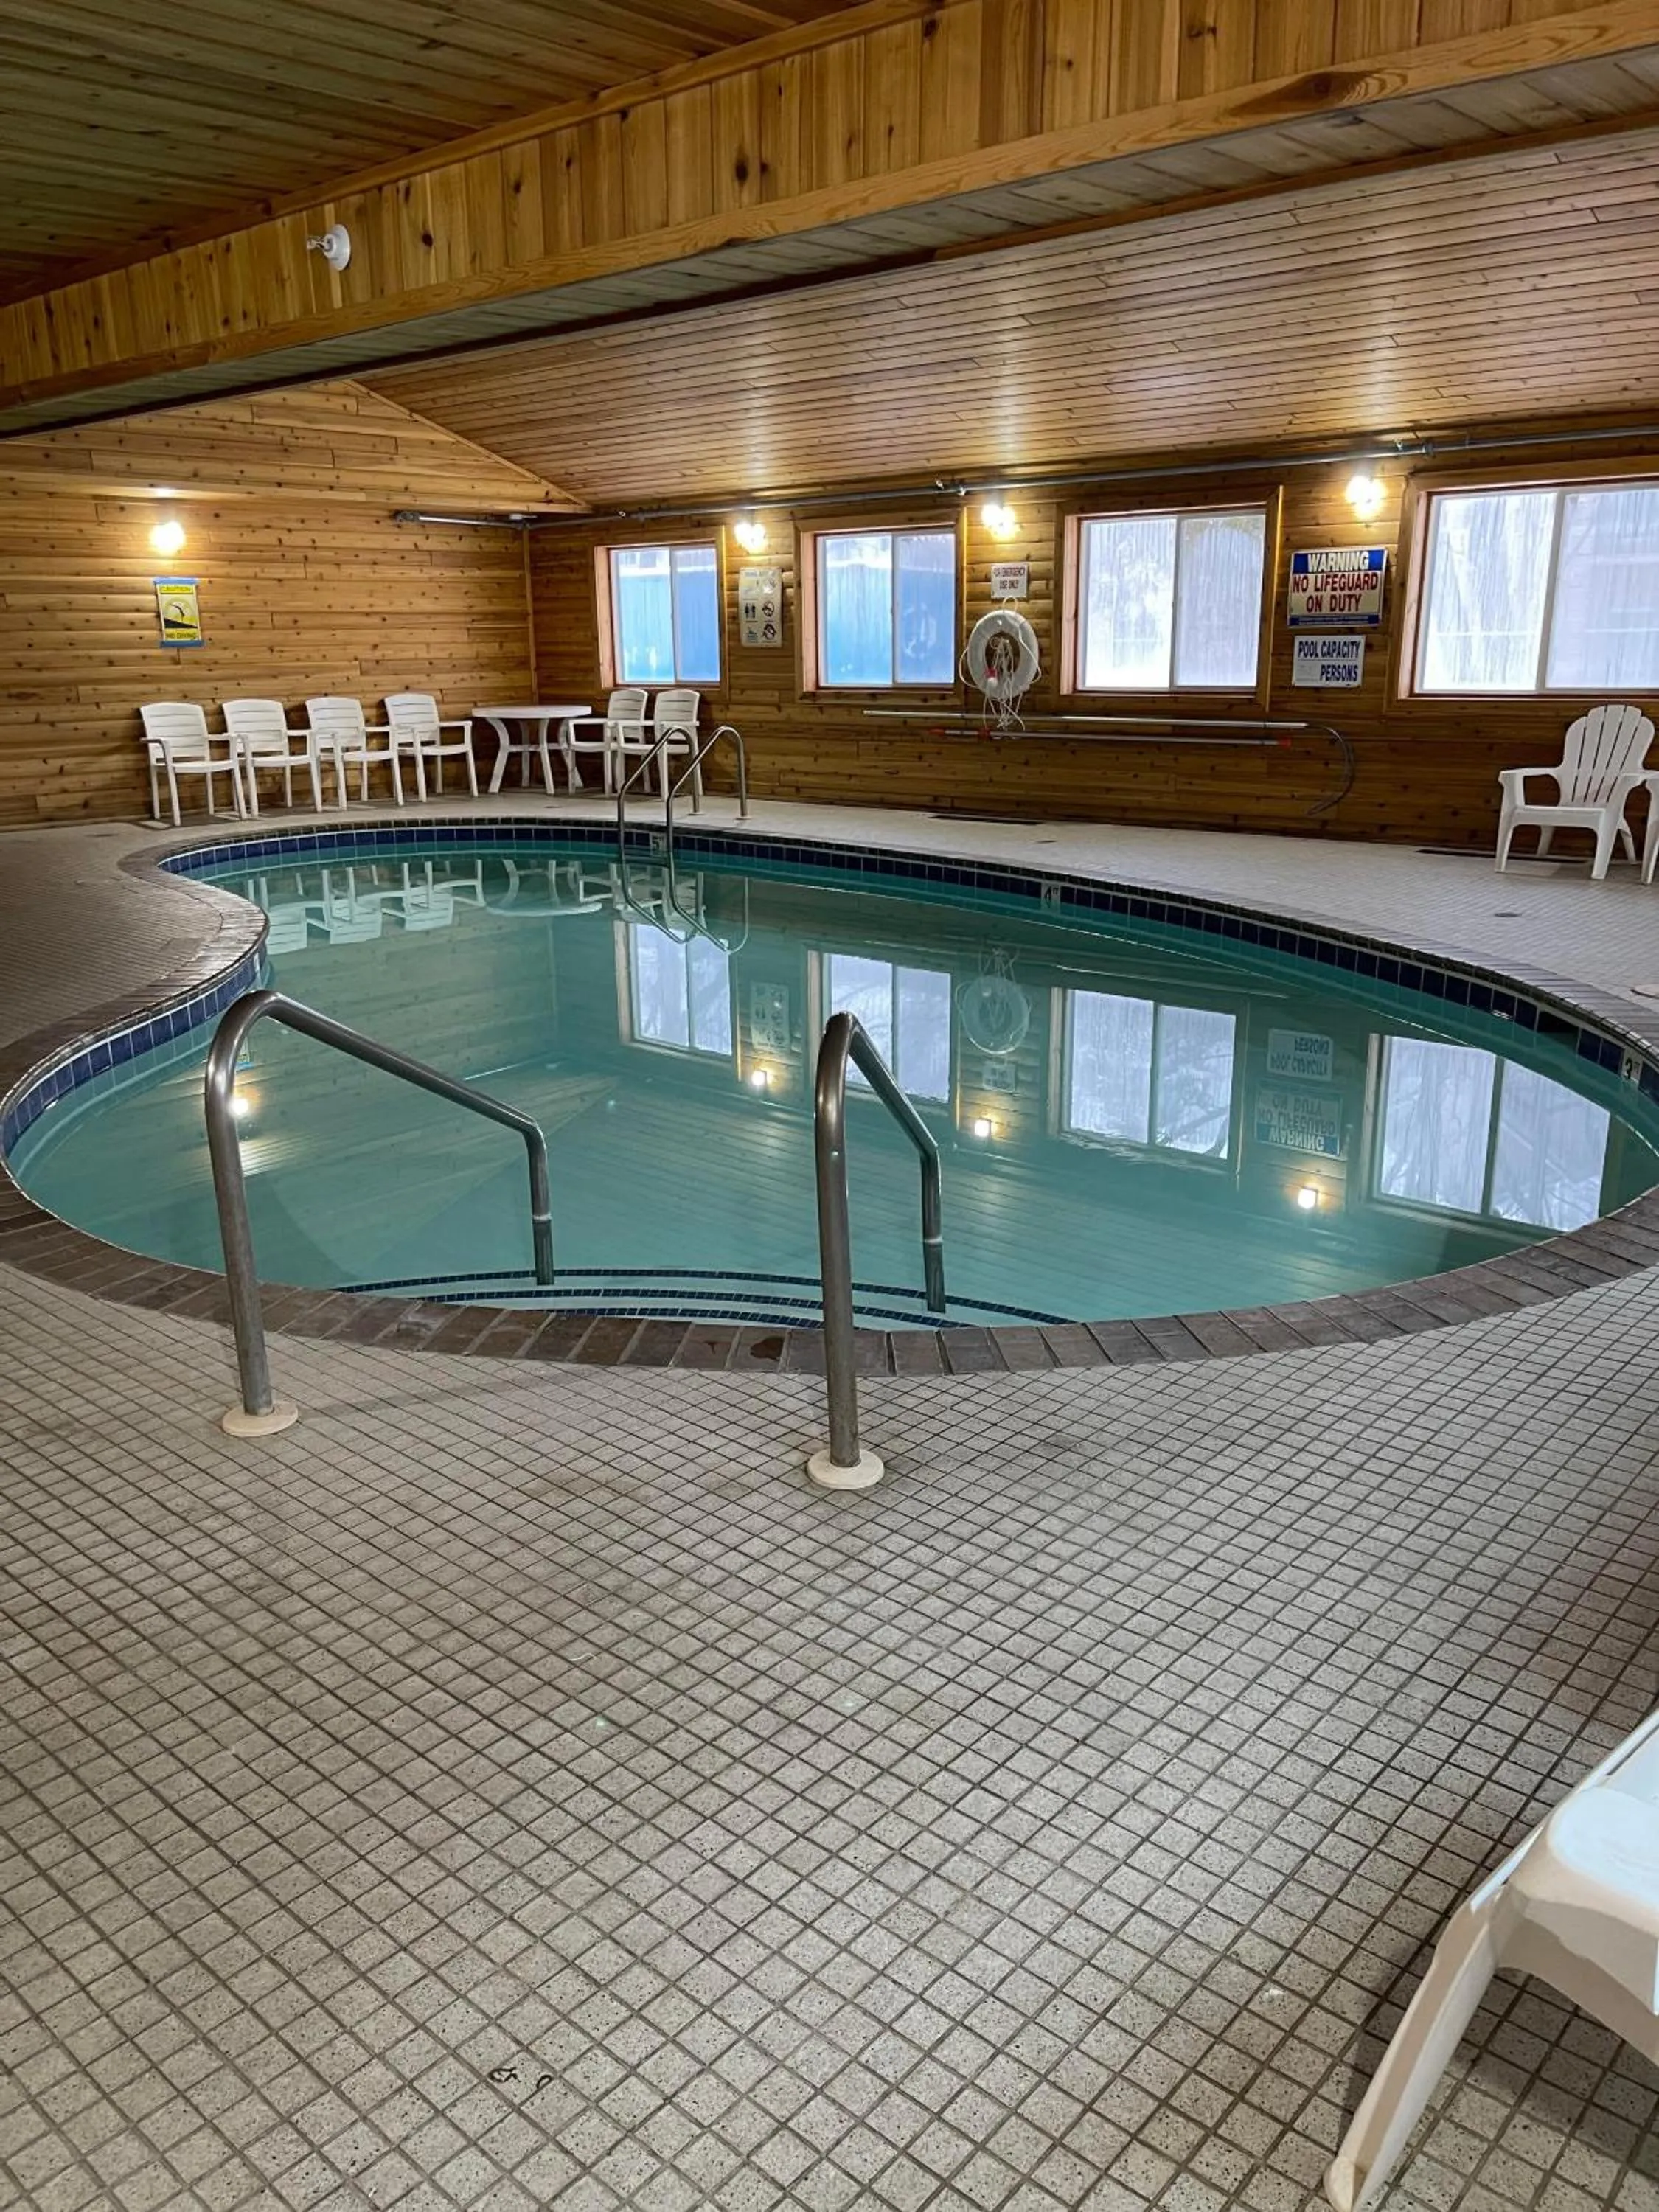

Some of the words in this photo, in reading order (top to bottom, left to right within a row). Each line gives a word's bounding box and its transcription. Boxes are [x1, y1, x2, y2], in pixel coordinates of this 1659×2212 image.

[1307, 551, 1369, 573] WARNING
[1293, 575, 1310, 593] NO
[1314, 572, 1378, 592] LIFEGUARD
[1306, 595, 1323, 613] ON
[1329, 593, 1363, 612] DUTY
[1298, 640, 1319, 658] POOL
[1321, 640, 1361, 658] CAPACITY
[1319, 664, 1359, 682] PERSONS
